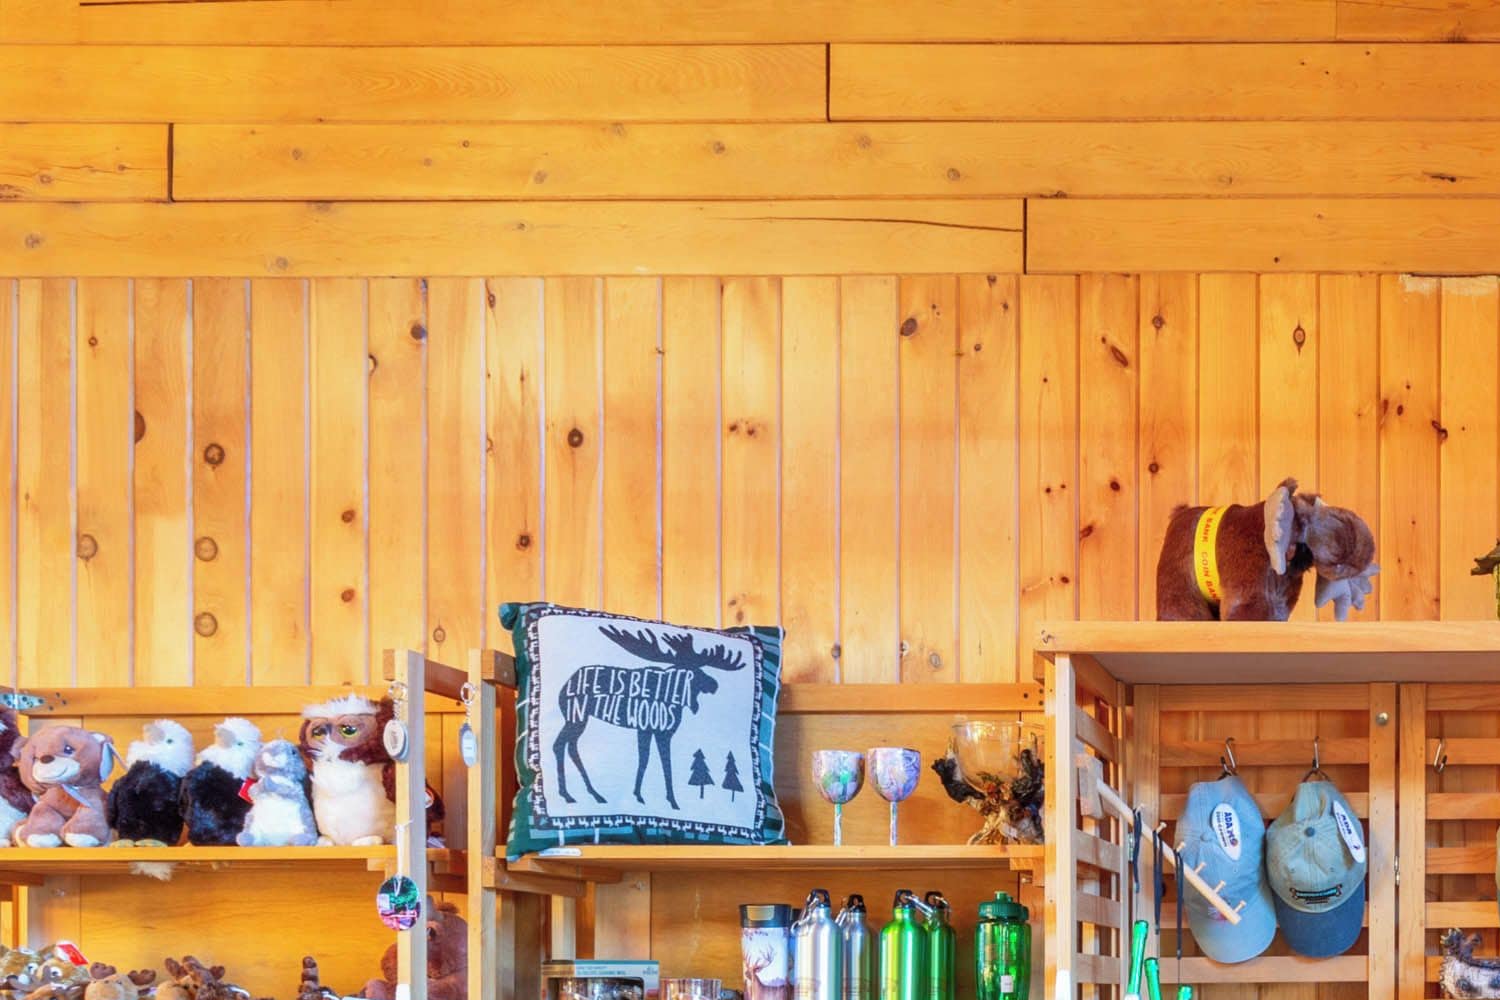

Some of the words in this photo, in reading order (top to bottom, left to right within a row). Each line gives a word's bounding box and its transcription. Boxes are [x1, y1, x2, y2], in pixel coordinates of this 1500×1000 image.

[566, 667, 605, 697] LIFE
[609, 669, 627, 695] IS
[629, 668, 695, 707] BETTER
[567, 694, 588, 724] IN
[594, 694, 625, 725] THE
[626, 697, 677, 731] WOODS
